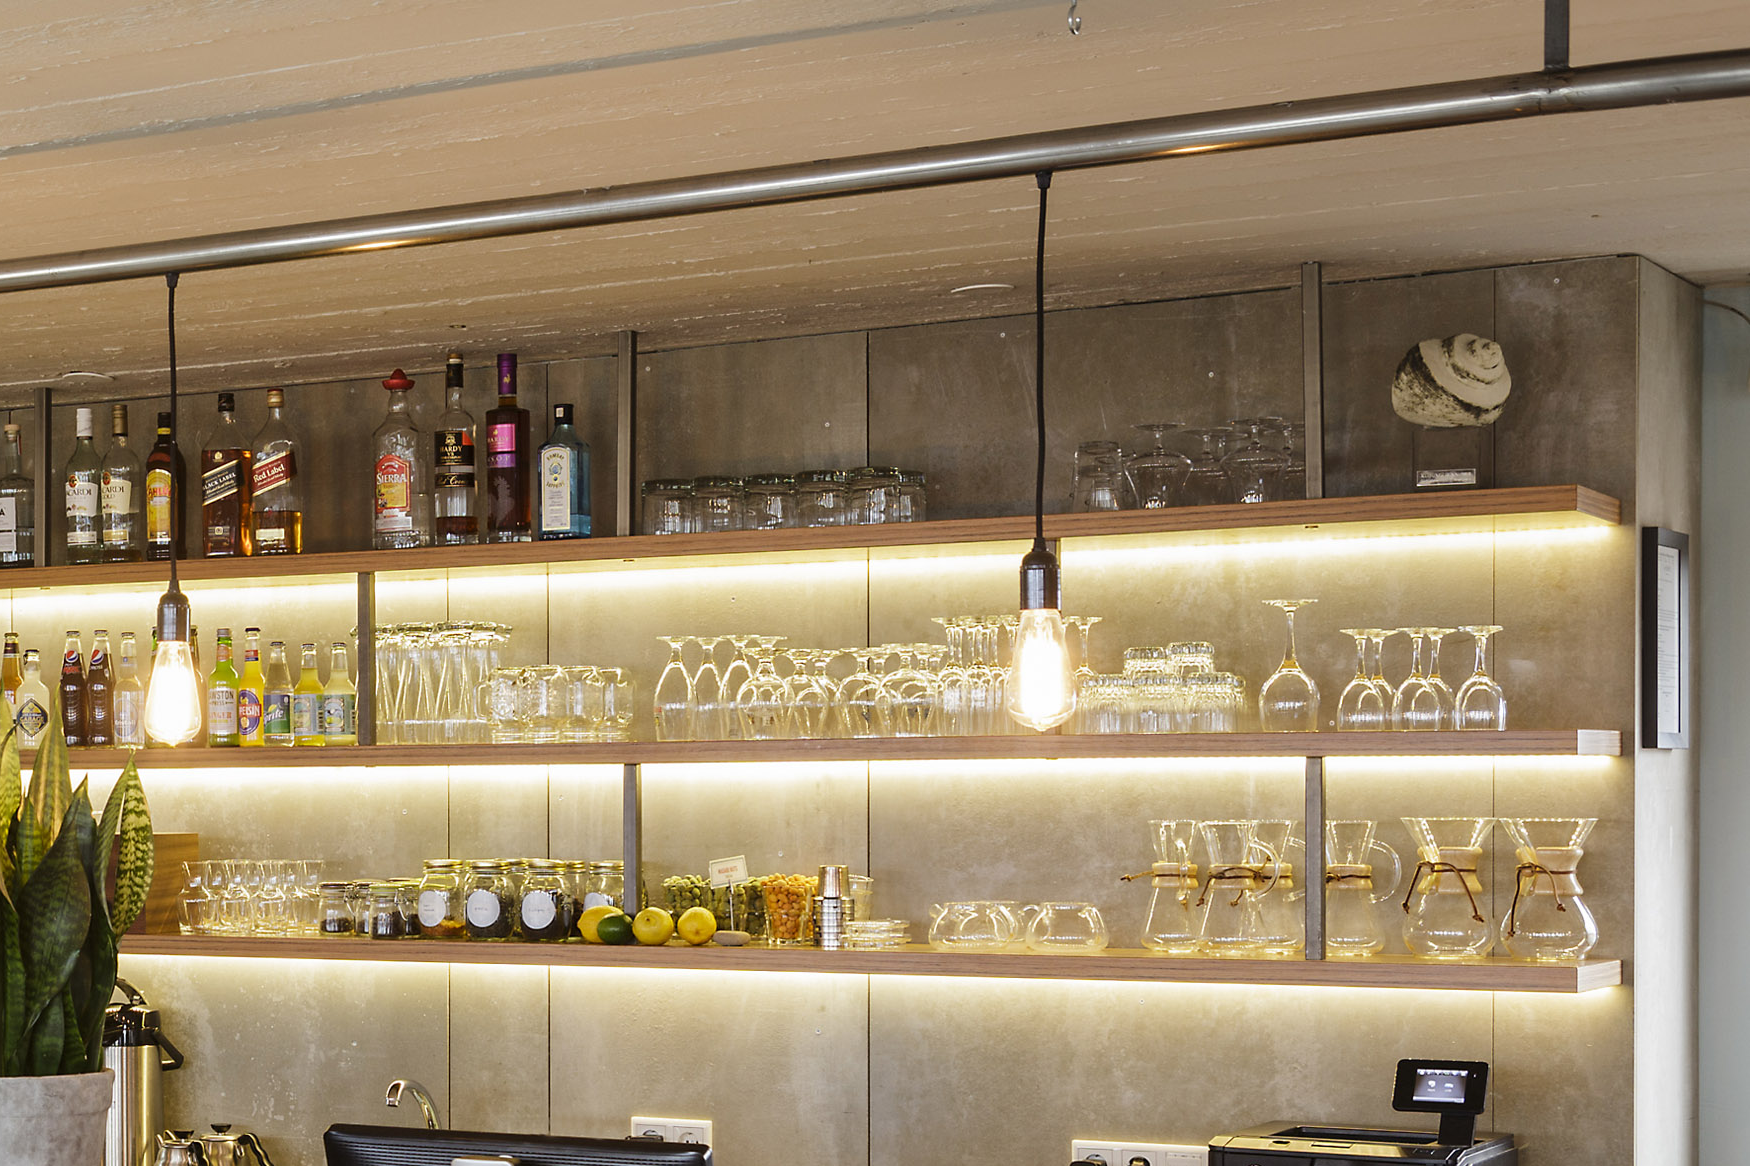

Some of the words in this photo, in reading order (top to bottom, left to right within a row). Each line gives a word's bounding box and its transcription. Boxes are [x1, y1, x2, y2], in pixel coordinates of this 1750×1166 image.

[219, 471, 237, 483] LABEL
[252, 472, 267, 483] Red
[266, 463, 285, 477] Label
[376, 471, 408, 485] SIERRA
